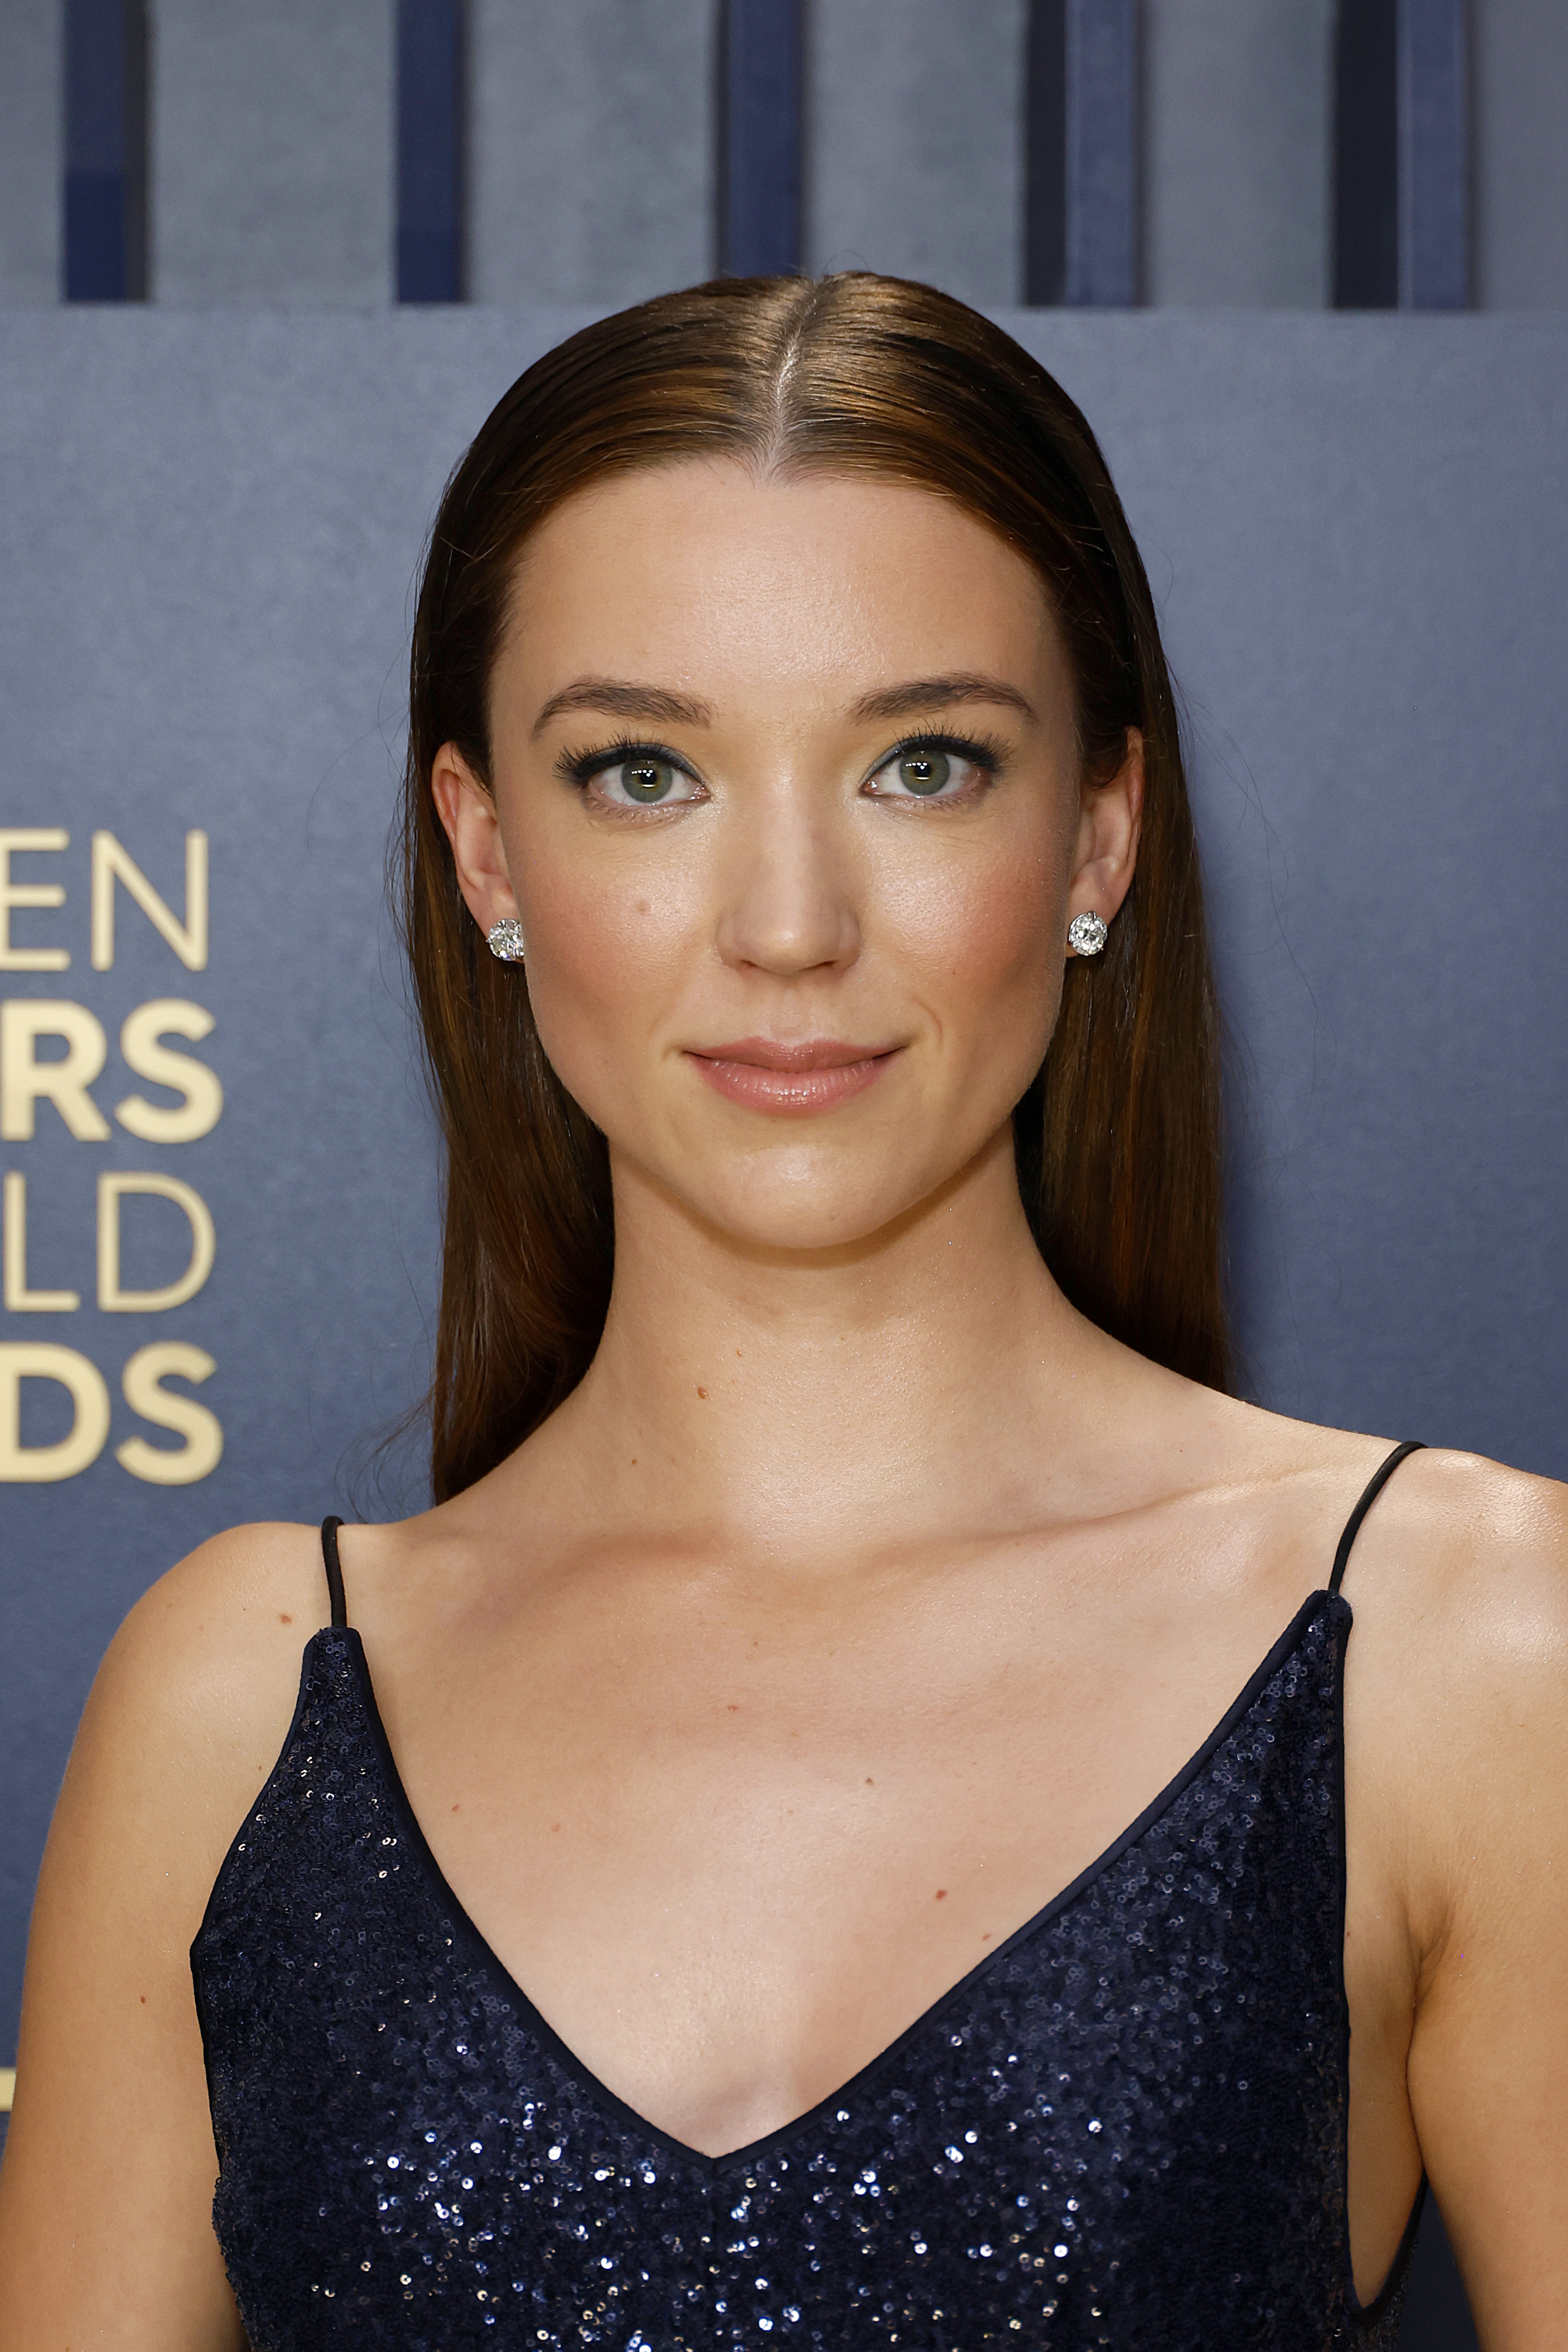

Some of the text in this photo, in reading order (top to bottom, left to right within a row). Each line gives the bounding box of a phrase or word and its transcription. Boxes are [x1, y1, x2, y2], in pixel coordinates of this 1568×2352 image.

[0, 828, 209, 972] EN
[0, 997, 224, 1144] RS
[3, 1170, 215, 1313] LD
[0, 1341, 223, 1485] DS
